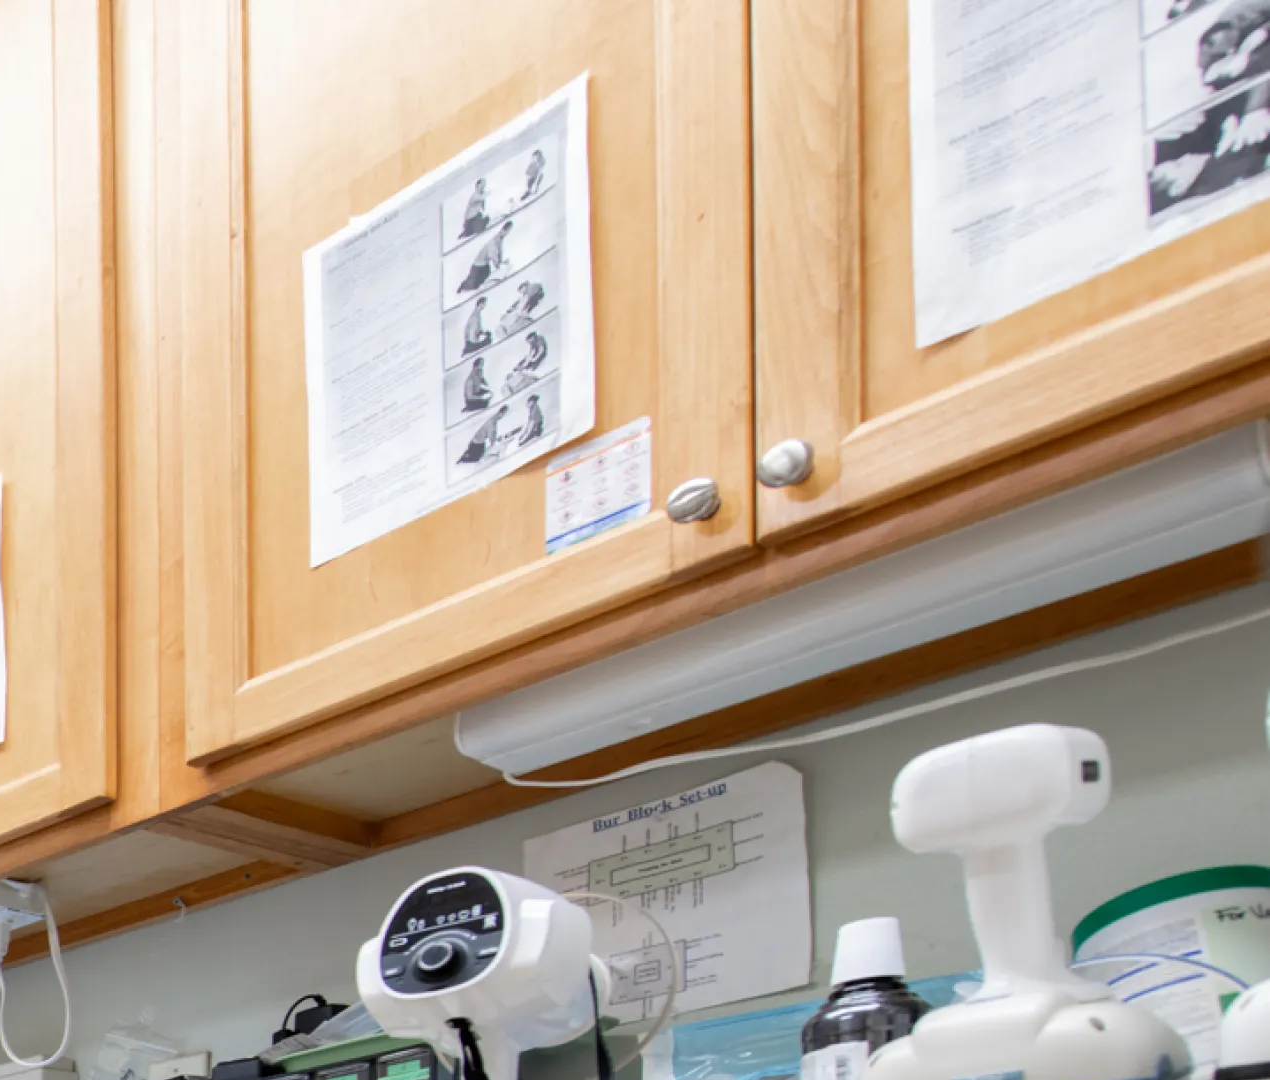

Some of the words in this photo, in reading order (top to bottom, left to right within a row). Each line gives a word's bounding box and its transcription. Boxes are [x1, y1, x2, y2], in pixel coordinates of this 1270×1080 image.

[593, 816, 621, 832] Bur
[628, 800, 672, 821] Block
[679, 783, 726, 806] Set-up
